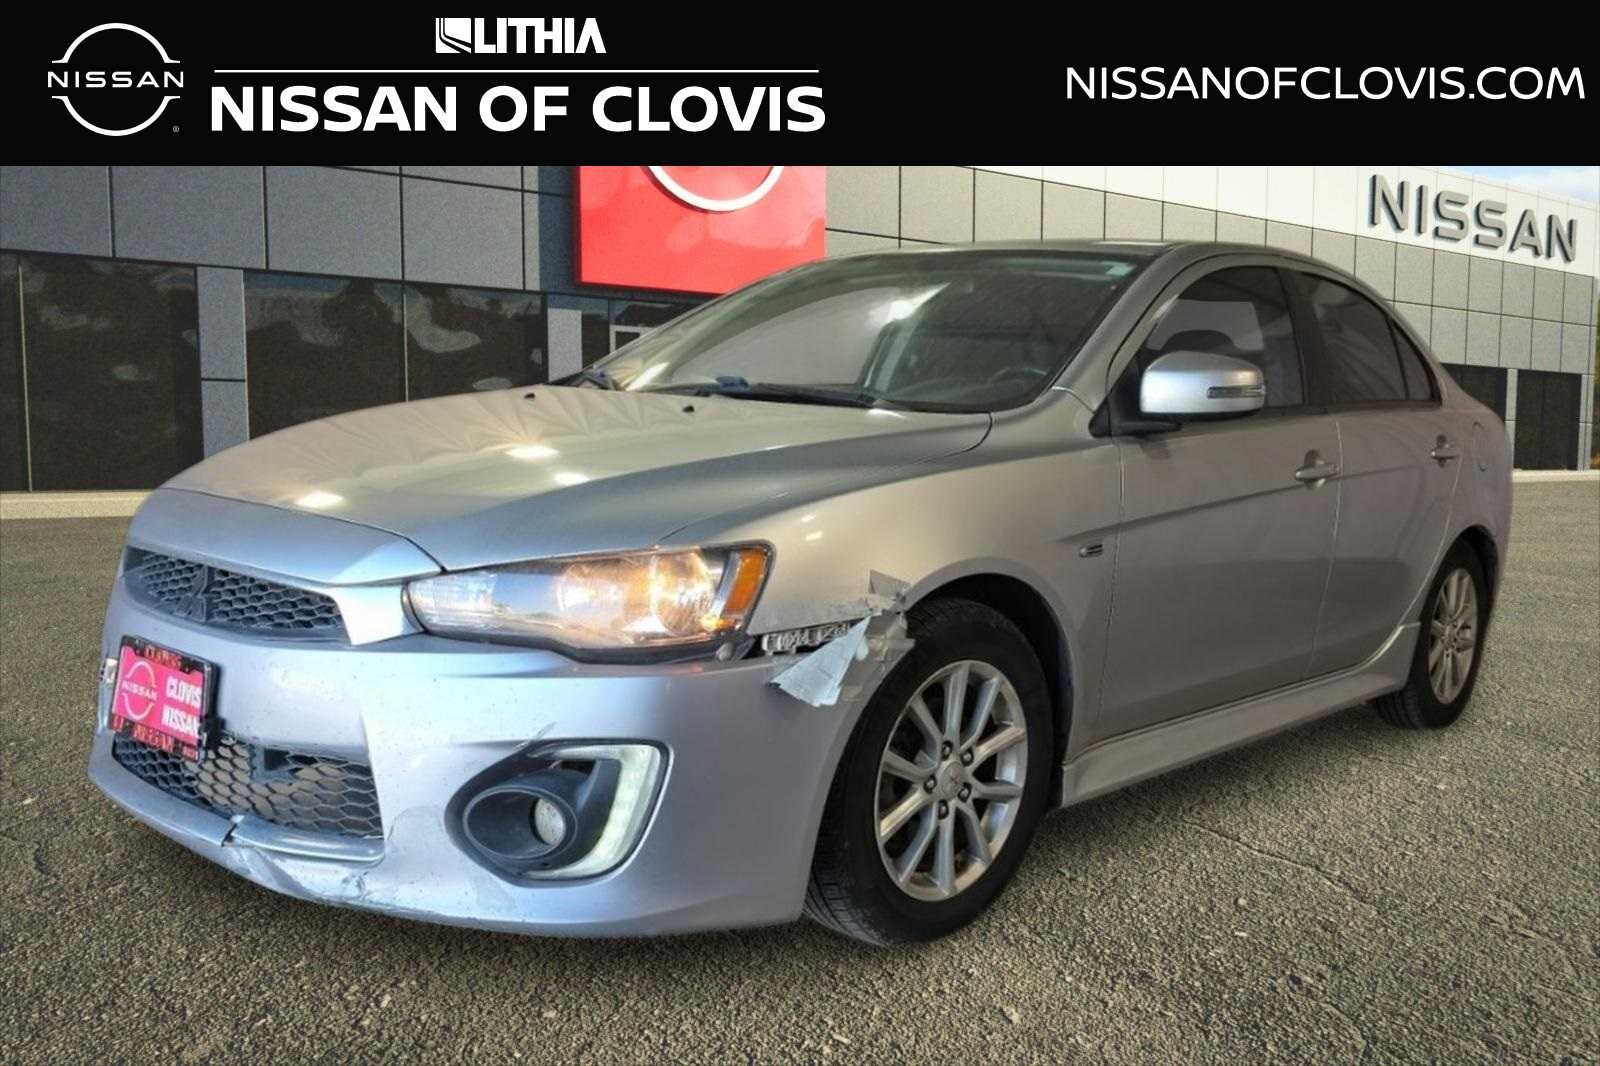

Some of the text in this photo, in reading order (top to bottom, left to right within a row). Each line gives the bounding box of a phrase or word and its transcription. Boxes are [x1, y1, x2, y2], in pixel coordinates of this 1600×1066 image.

[1368, 174, 1577, 263] NISSAN
[121, 679, 158, 702] NISSAN
[165, 676, 202, 709] CLOVIS
